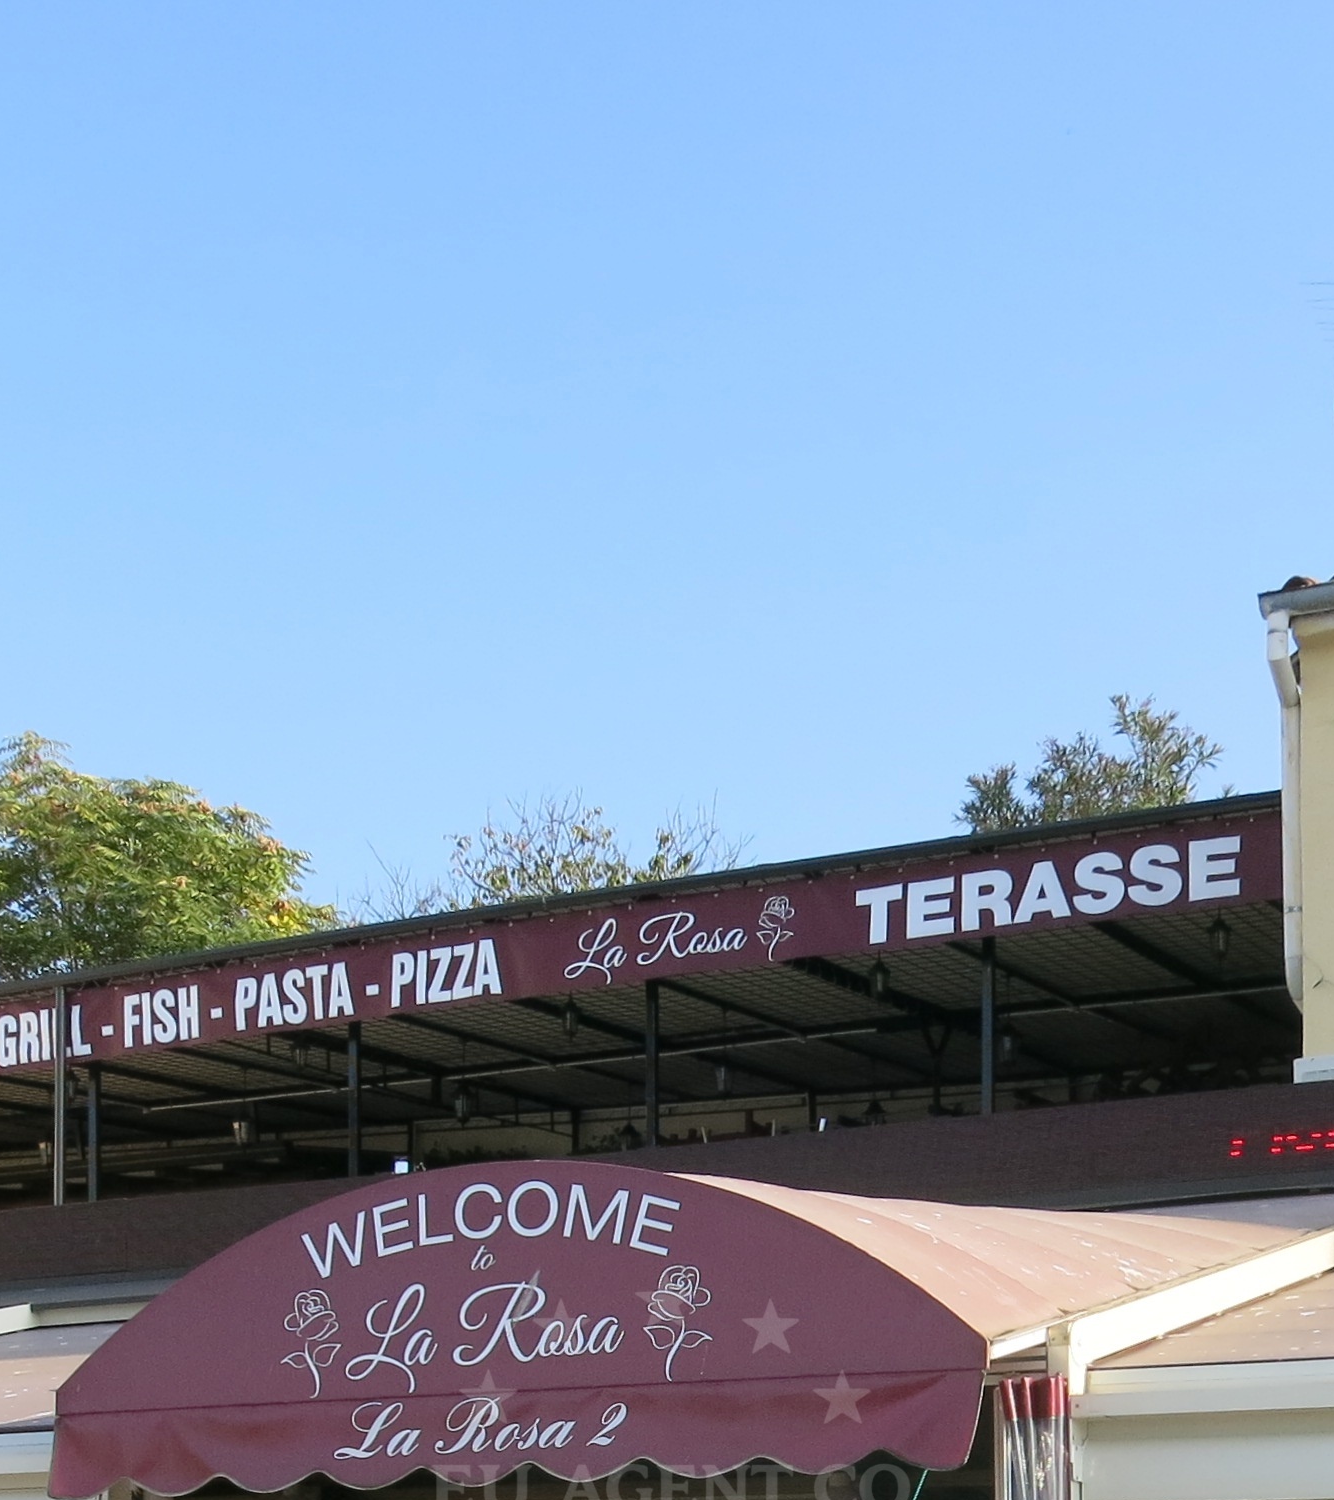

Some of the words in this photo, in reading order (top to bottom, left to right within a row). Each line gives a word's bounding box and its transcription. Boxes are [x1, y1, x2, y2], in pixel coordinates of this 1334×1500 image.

[855, 835, 1243, 946] TERASSE
[123, 984, 200, 1049] FISH
[235, 961, 355, 1031] PASTA
[390, 938, 503, 1009] PIZZA
[563, 917, 627, 986] La
[635, 911, 748, 967] Rosa
[300, 1180, 681, 1280] WELCOME
[470, 1244, 496, 1271] to
[345, 1283, 438, 1393] La
[453, 1280, 626, 1366] Rosa
[333, 1401, 421, 1461] La
[435, 1396, 573, 1457] Rosa
[590, 1403, 628, 1446] 2
